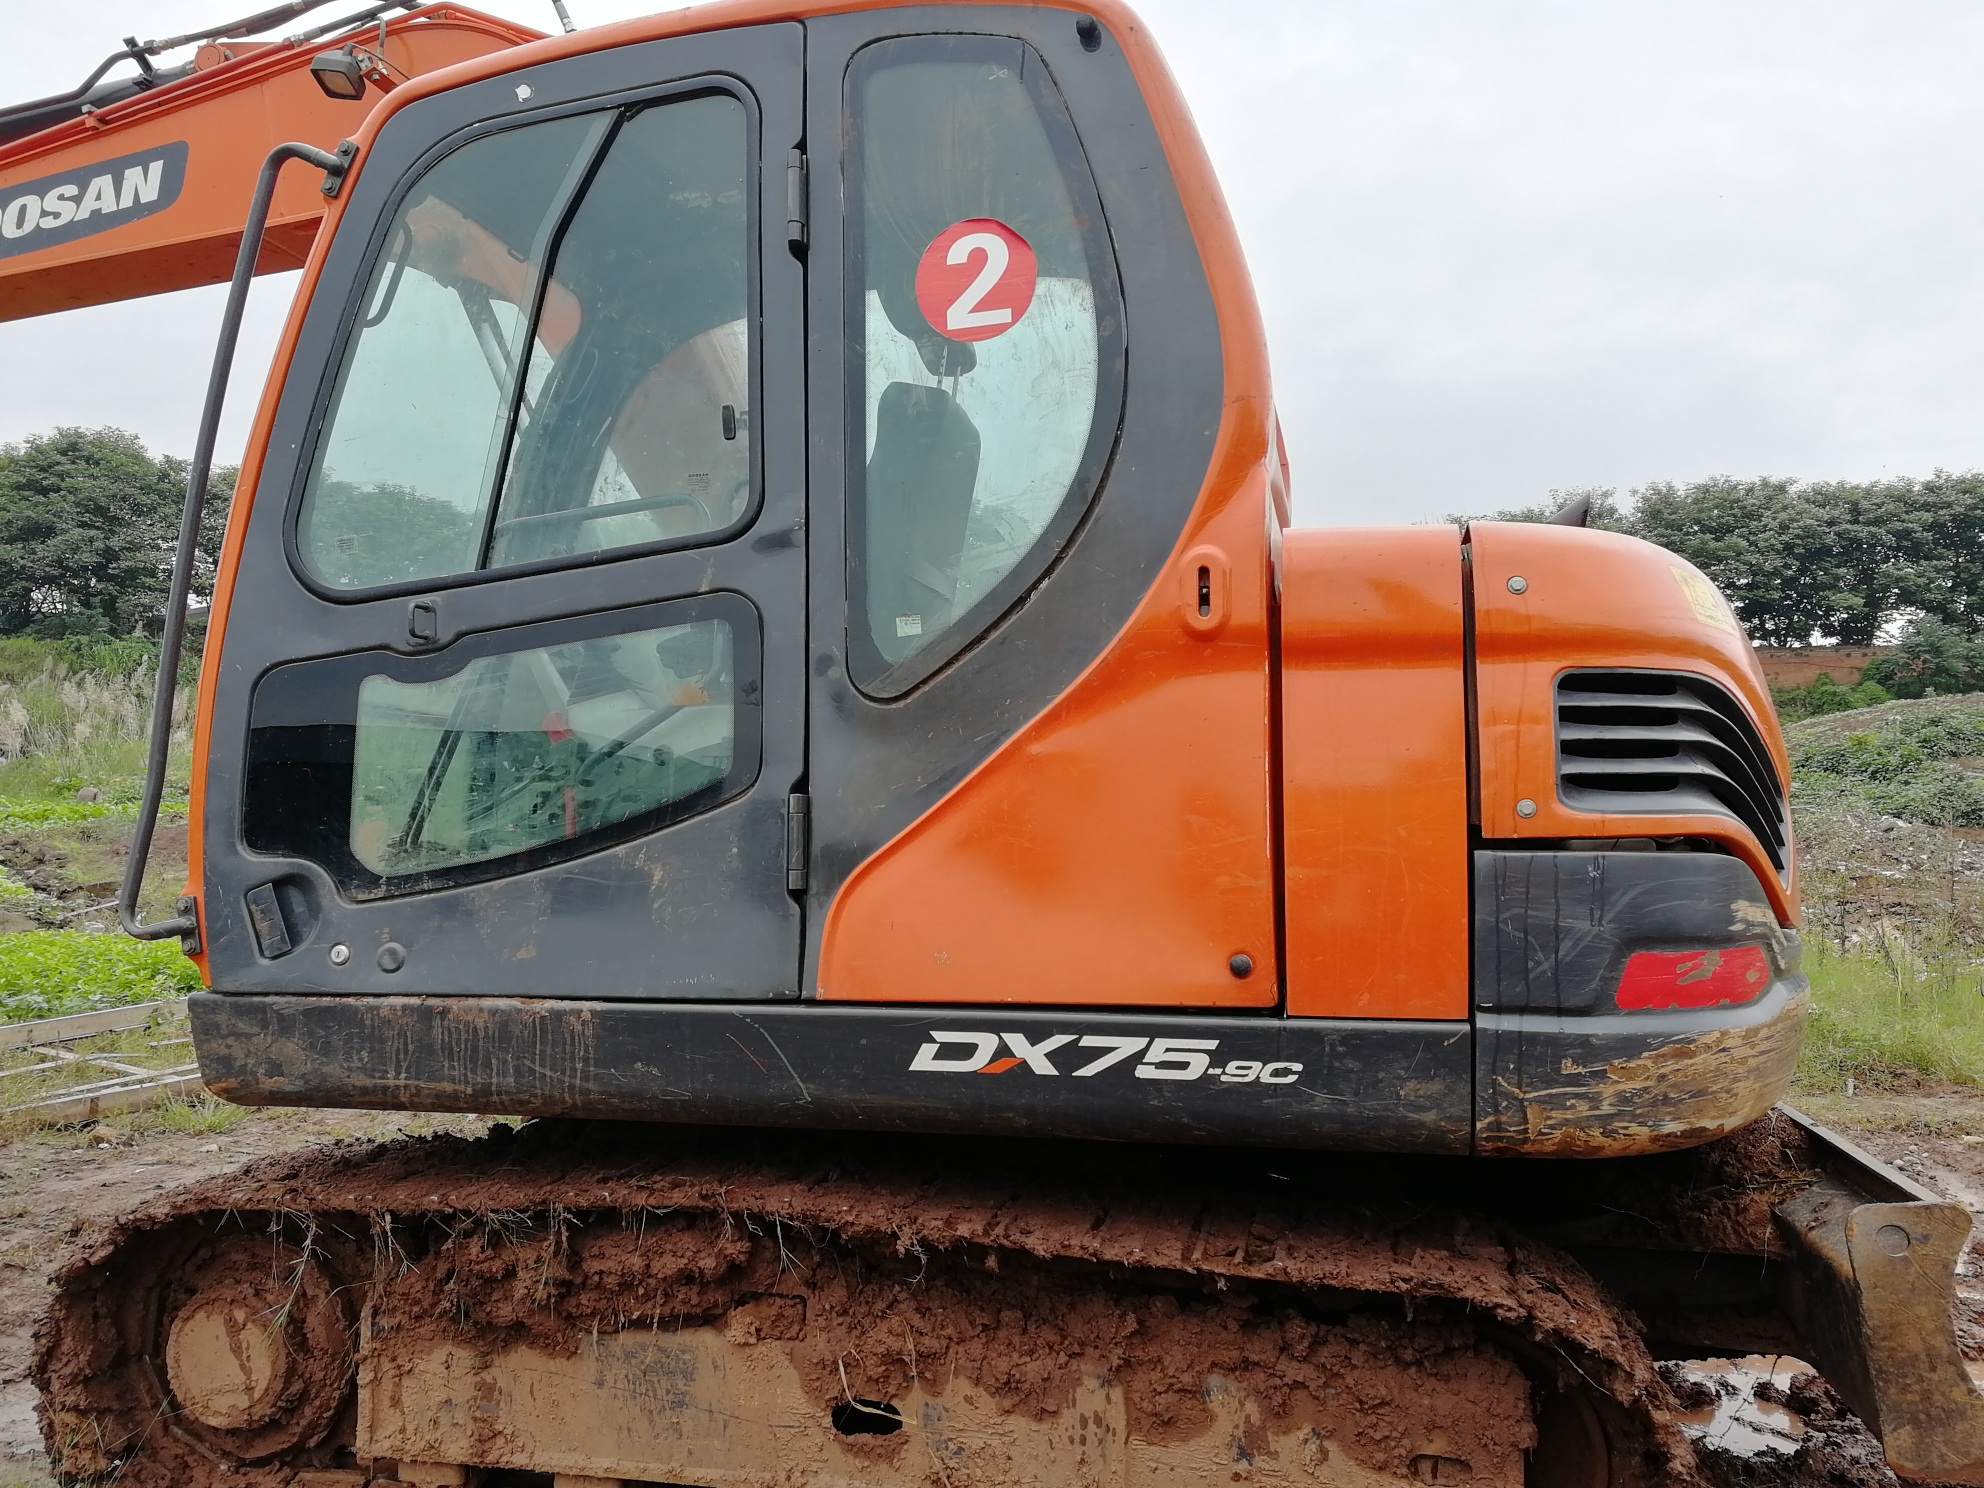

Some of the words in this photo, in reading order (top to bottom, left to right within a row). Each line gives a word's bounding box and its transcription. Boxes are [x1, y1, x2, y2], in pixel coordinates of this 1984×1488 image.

[0, 159, 164, 239] OSAN
[946, 232, 1013, 331] 2
[908, 1030, 1303, 1084] DX75-9C
